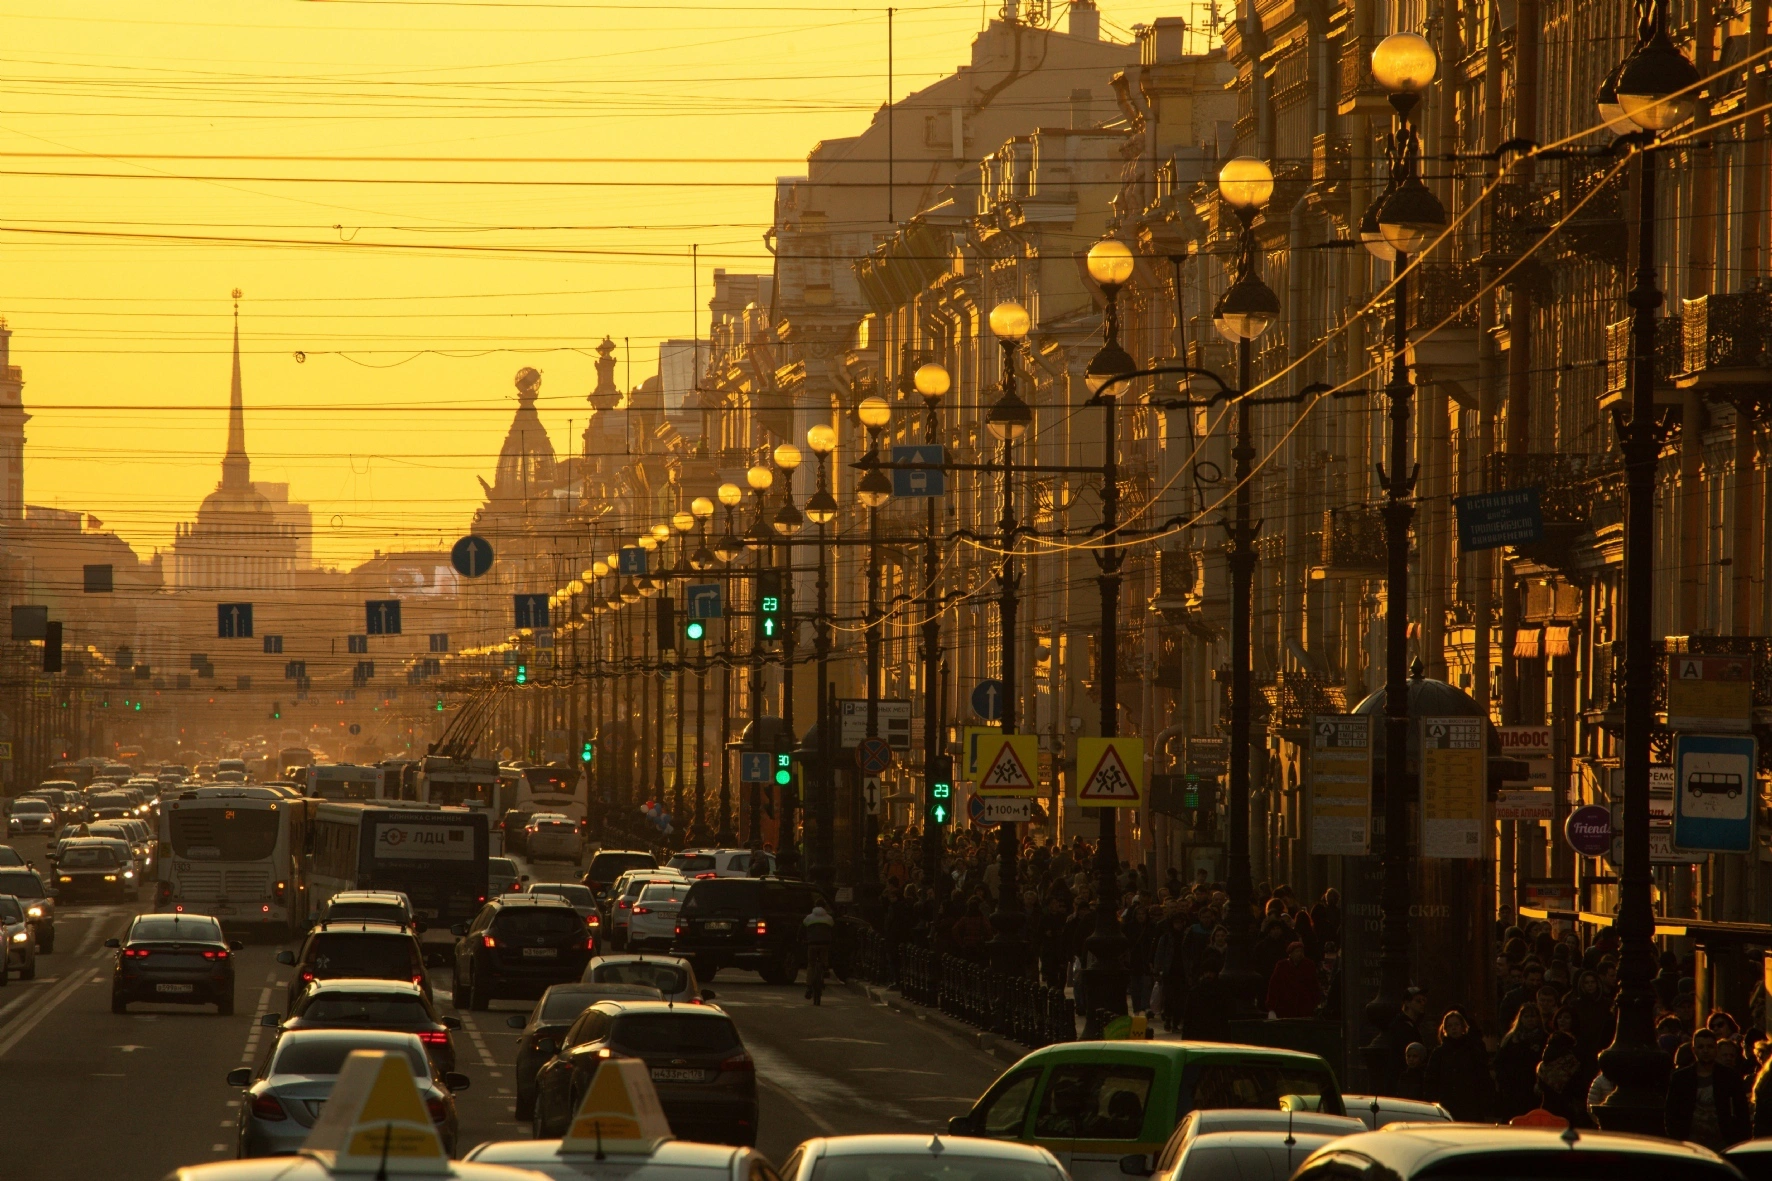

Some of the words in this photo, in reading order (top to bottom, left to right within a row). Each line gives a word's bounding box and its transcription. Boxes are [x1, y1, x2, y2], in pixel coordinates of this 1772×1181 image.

[1467, 493, 1529, 510] ОСТАНОВКА
[763, 597, 778, 611] 23
[1683, 661, 1698, 678] А
[1322, 724, 1332, 734] А
[1432, 725, 1443, 736] А
[778, 755, 789, 766] 30
[934, 784, 949, 798] 23
[225, 810, 235, 820] 24
[995, 805, 1020, 815] 100м
[1521, 808, 1554, 818] АППАРАТЫ
[388, 813, 424, 821] КЛИНИКА
[413, 831, 446, 845] ЛДЦ
[173, 863, 191, 872] 1303
